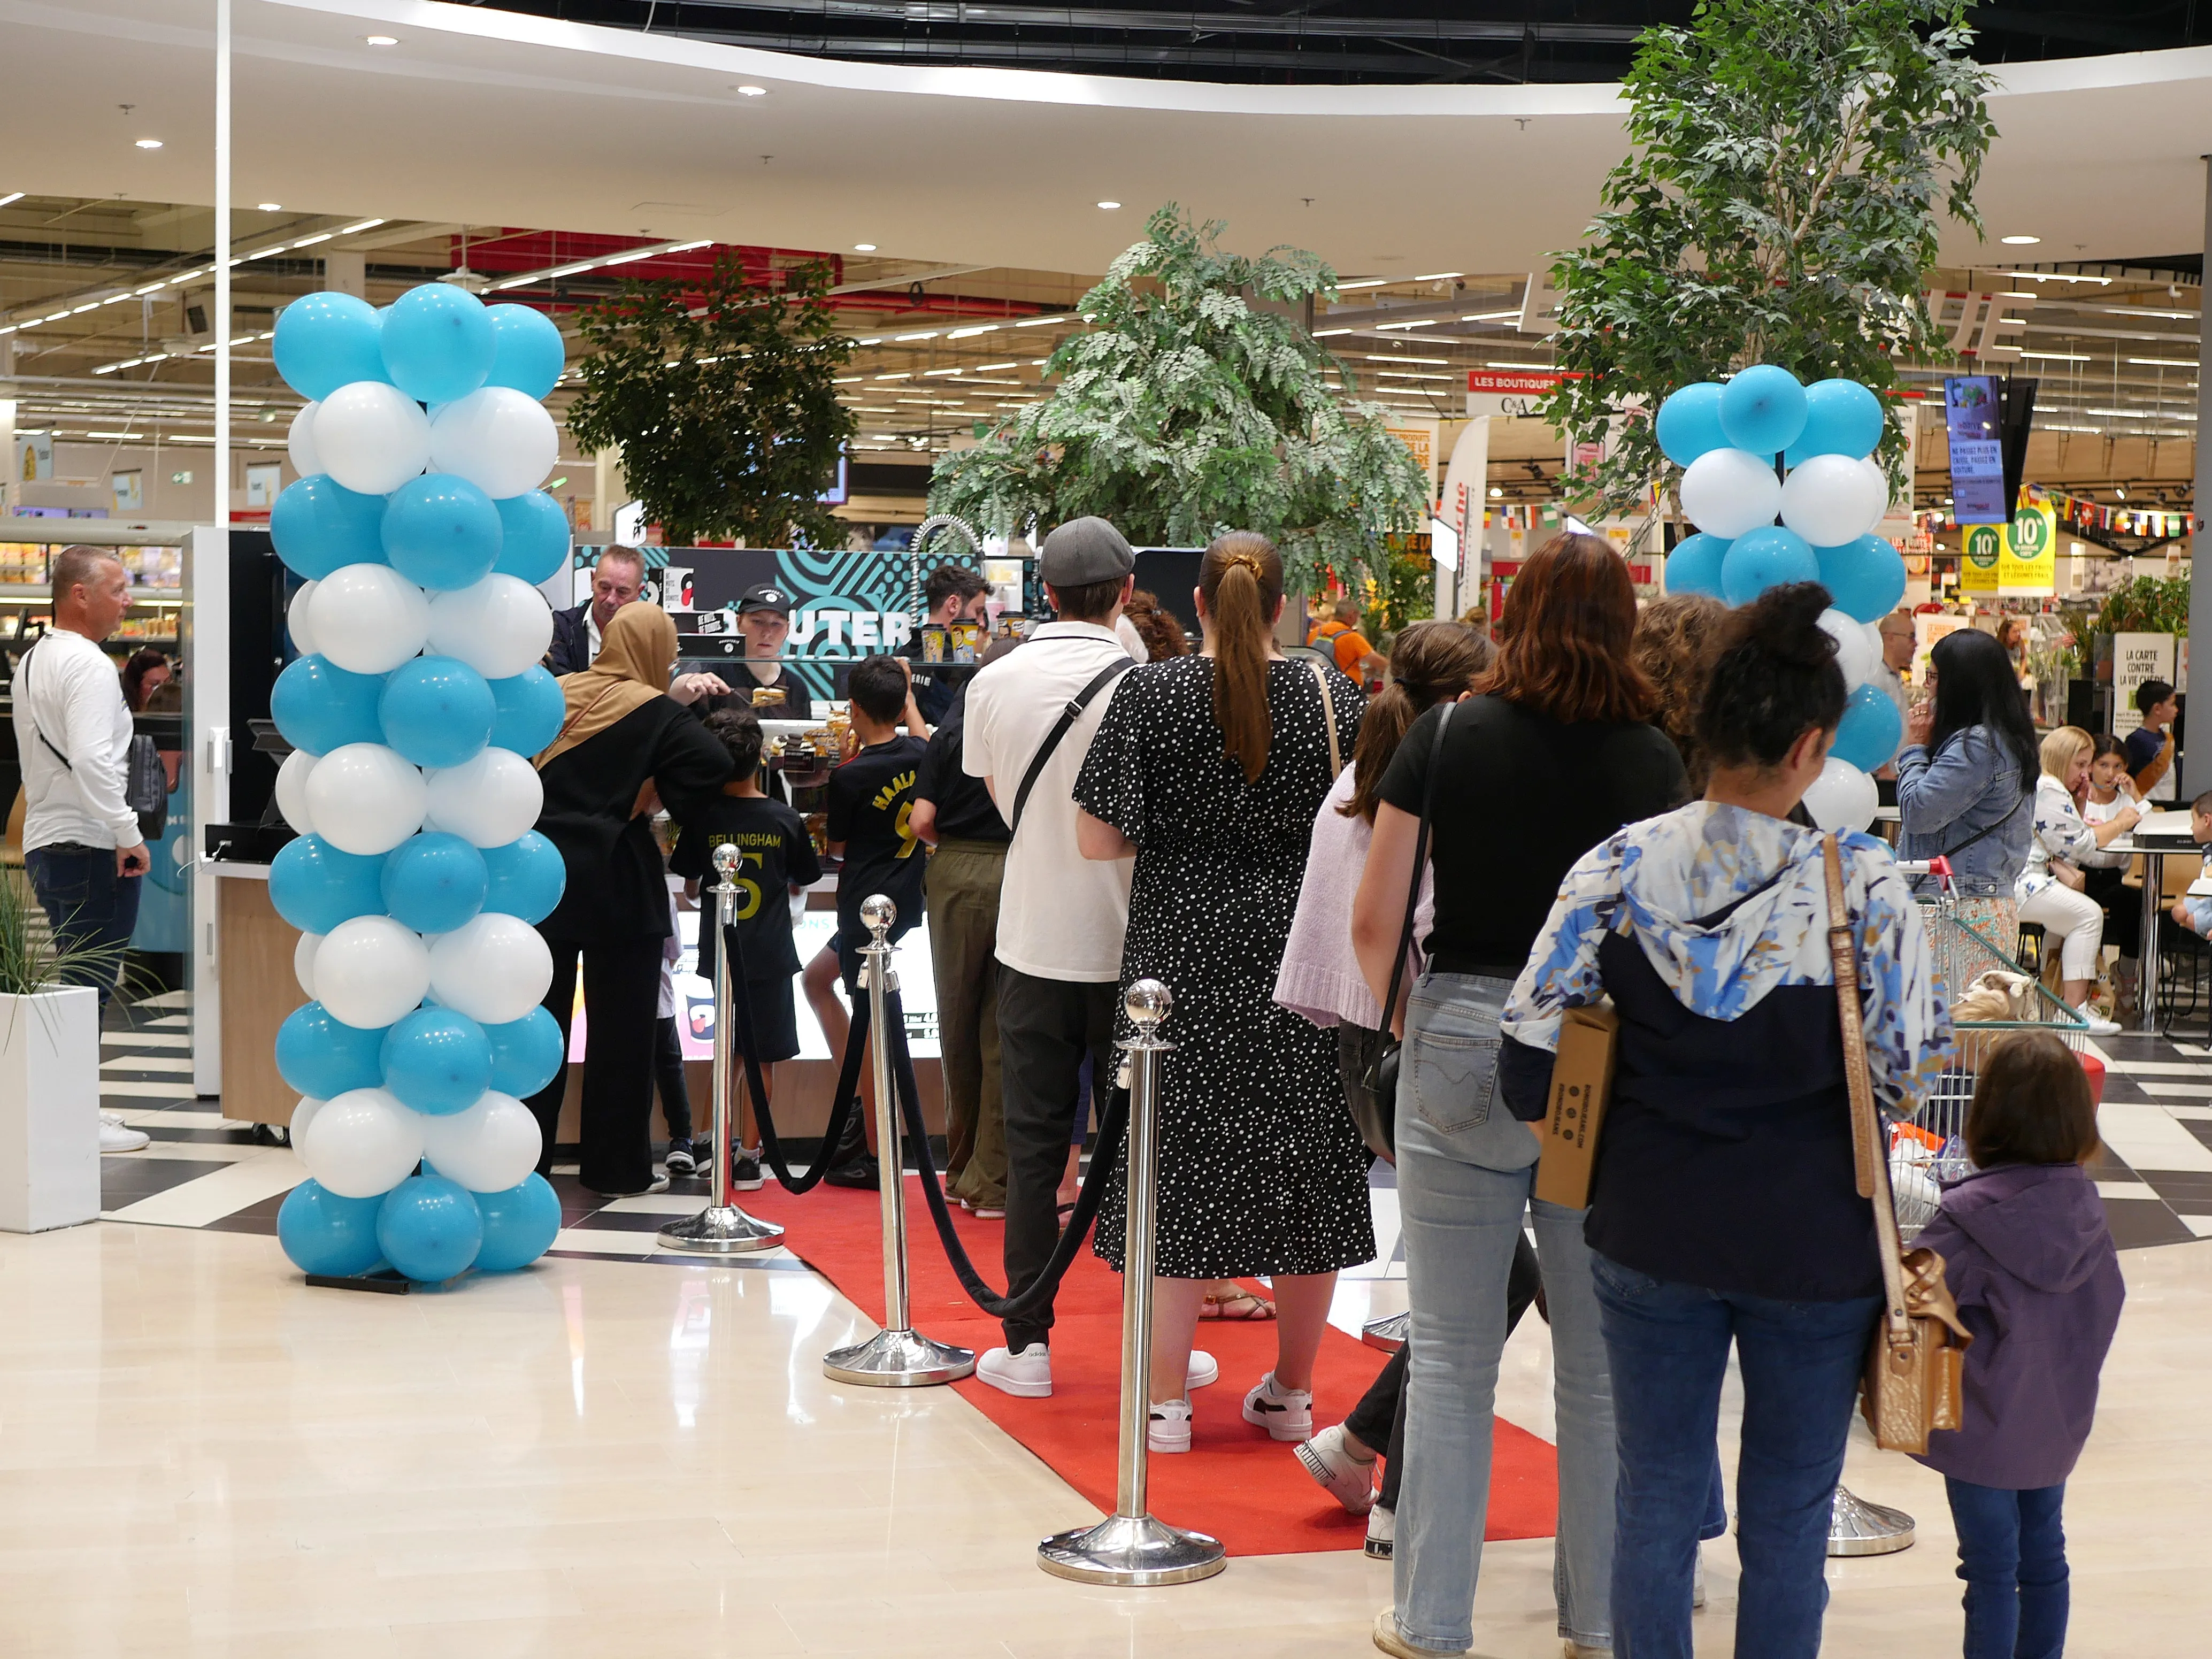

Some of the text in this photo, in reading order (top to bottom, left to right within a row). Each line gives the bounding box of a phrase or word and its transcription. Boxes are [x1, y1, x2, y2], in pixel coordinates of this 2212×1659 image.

[1474, 377, 1494, 387] LES
[1501, 397, 1529, 415] C&A
[1418, 443, 1430, 452] LA
[787, 610, 931, 647] UTER
[2126, 649, 2159, 661] LA CARTE
[2127, 662, 2155, 673] CONTRE
[2120, 675, 2127, 686] LA
[2128, 675, 2137, 686] VIE
[708, 833, 781, 848] BELLINGHAM
[731, 852, 763, 920] 5
